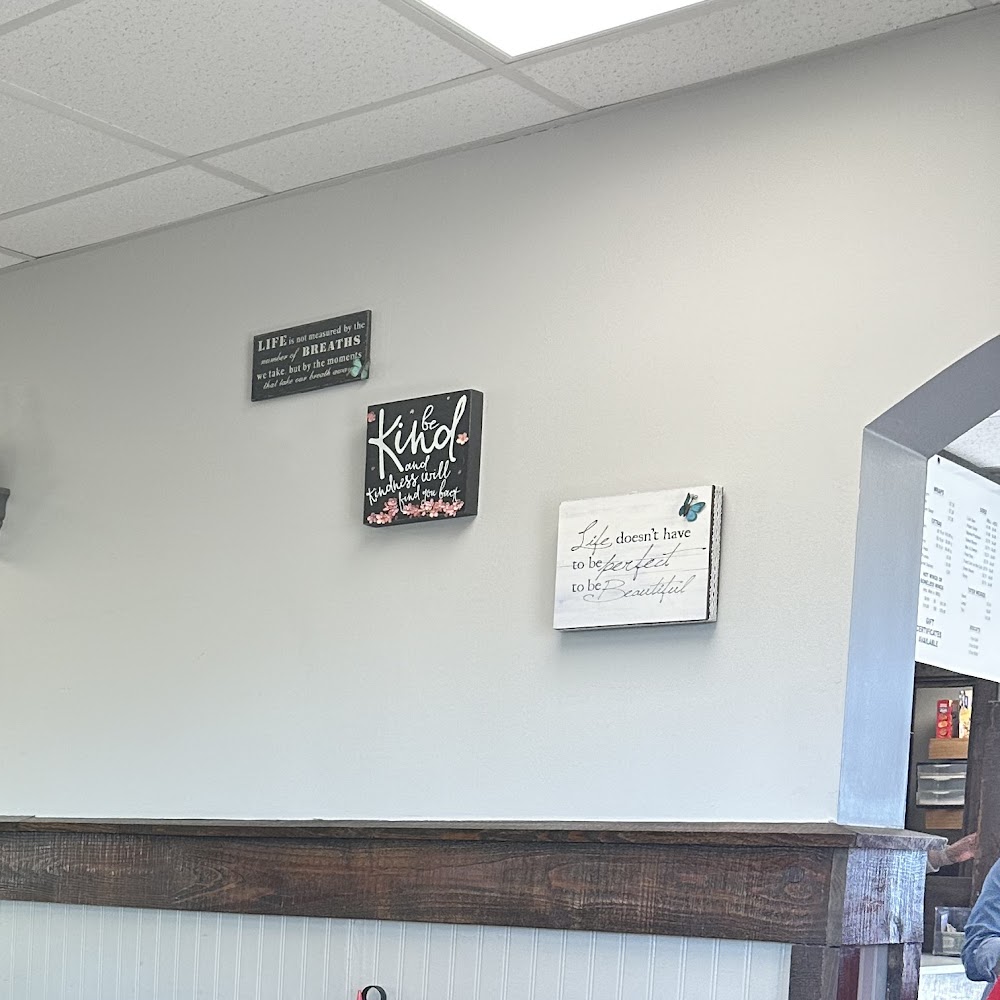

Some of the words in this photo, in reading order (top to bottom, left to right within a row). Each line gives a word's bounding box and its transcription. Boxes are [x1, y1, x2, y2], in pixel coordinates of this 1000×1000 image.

[258, 335, 287, 352] LIFE
[288, 337, 295, 346] is
[296, 335, 307, 344] not
[308, 326, 341, 341] measured
[343, 324, 351, 334] by
[354, 321, 365, 331] the
[289, 347, 300, 362] of
[302, 335, 361, 357] BREATHS
[257, 372, 267, 380] we
[289, 364, 300, 374] but
[303, 362, 311, 373] by
[313, 360, 325, 370] the
[327, 352, 362, 366] moments
[263, 379, 278, 390] that
[279, 375, 293, 387] take
[309, 368, 331, 381] breath
[421, 404, 440, 431] be
[405, 455, 430, 472] and
[421, 460, 452, 483] will
[398, 484, 421, 514] find
[421, 489, 437, 502] you
[571, 519, 613, 556] Life
[615, 528, 659, 544] doesn't
[663, 527, 691, 541] have
[572, 560, 585, 570] to
[589, 556, 603, 569] be
[595, 543, 706, 581] perfect
[572, 583, 585, 593] to
[583, 574, 696, 604] Beautiful
[588, 579, 602, 592] be
